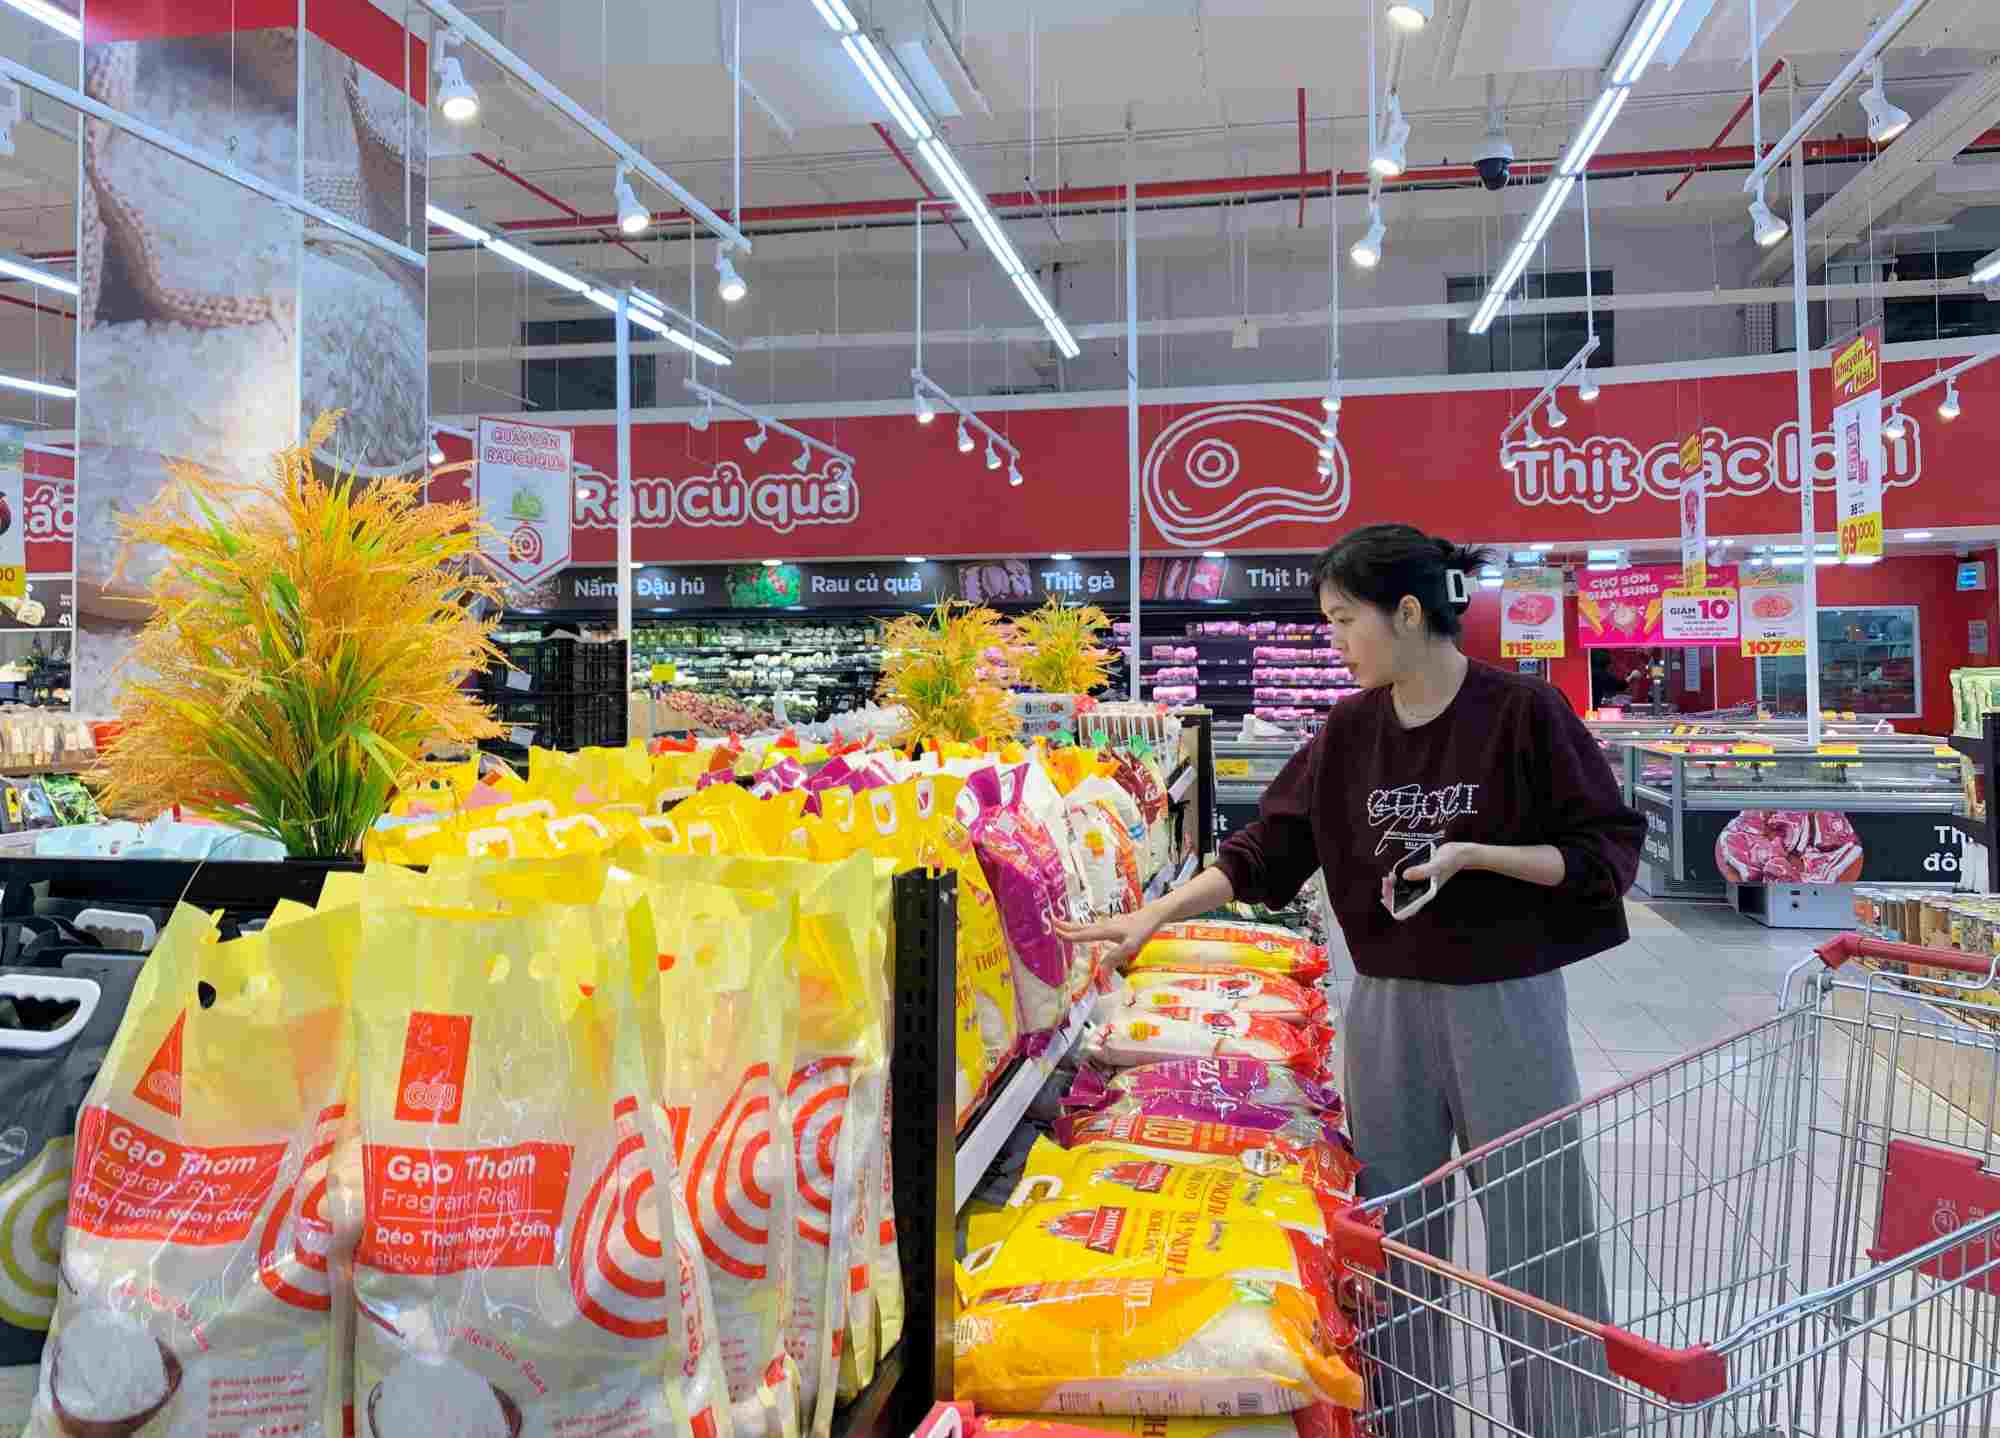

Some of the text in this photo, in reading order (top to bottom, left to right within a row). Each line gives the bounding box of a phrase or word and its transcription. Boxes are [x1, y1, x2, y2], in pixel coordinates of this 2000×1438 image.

[1518, 444, 1638, 509] Thịt
[1782, 424, 1912, 490] loi
[683, 463, 745, 519] củ
[755, 463, 853, 527] quả
[637, 576, 677, 600] Đậu
[811, 571, 923, 599] Rau củ quả
[1041, 570, 1116, 597] Thịt gà
[1246, 568, 1292, 592] Thịt
[107, 1126, 257, 1177] Gạo Thơm
[387, 1152, 537, 1189] Gạo Thơm
[381, 1188, 473, 1213] Fragrant
